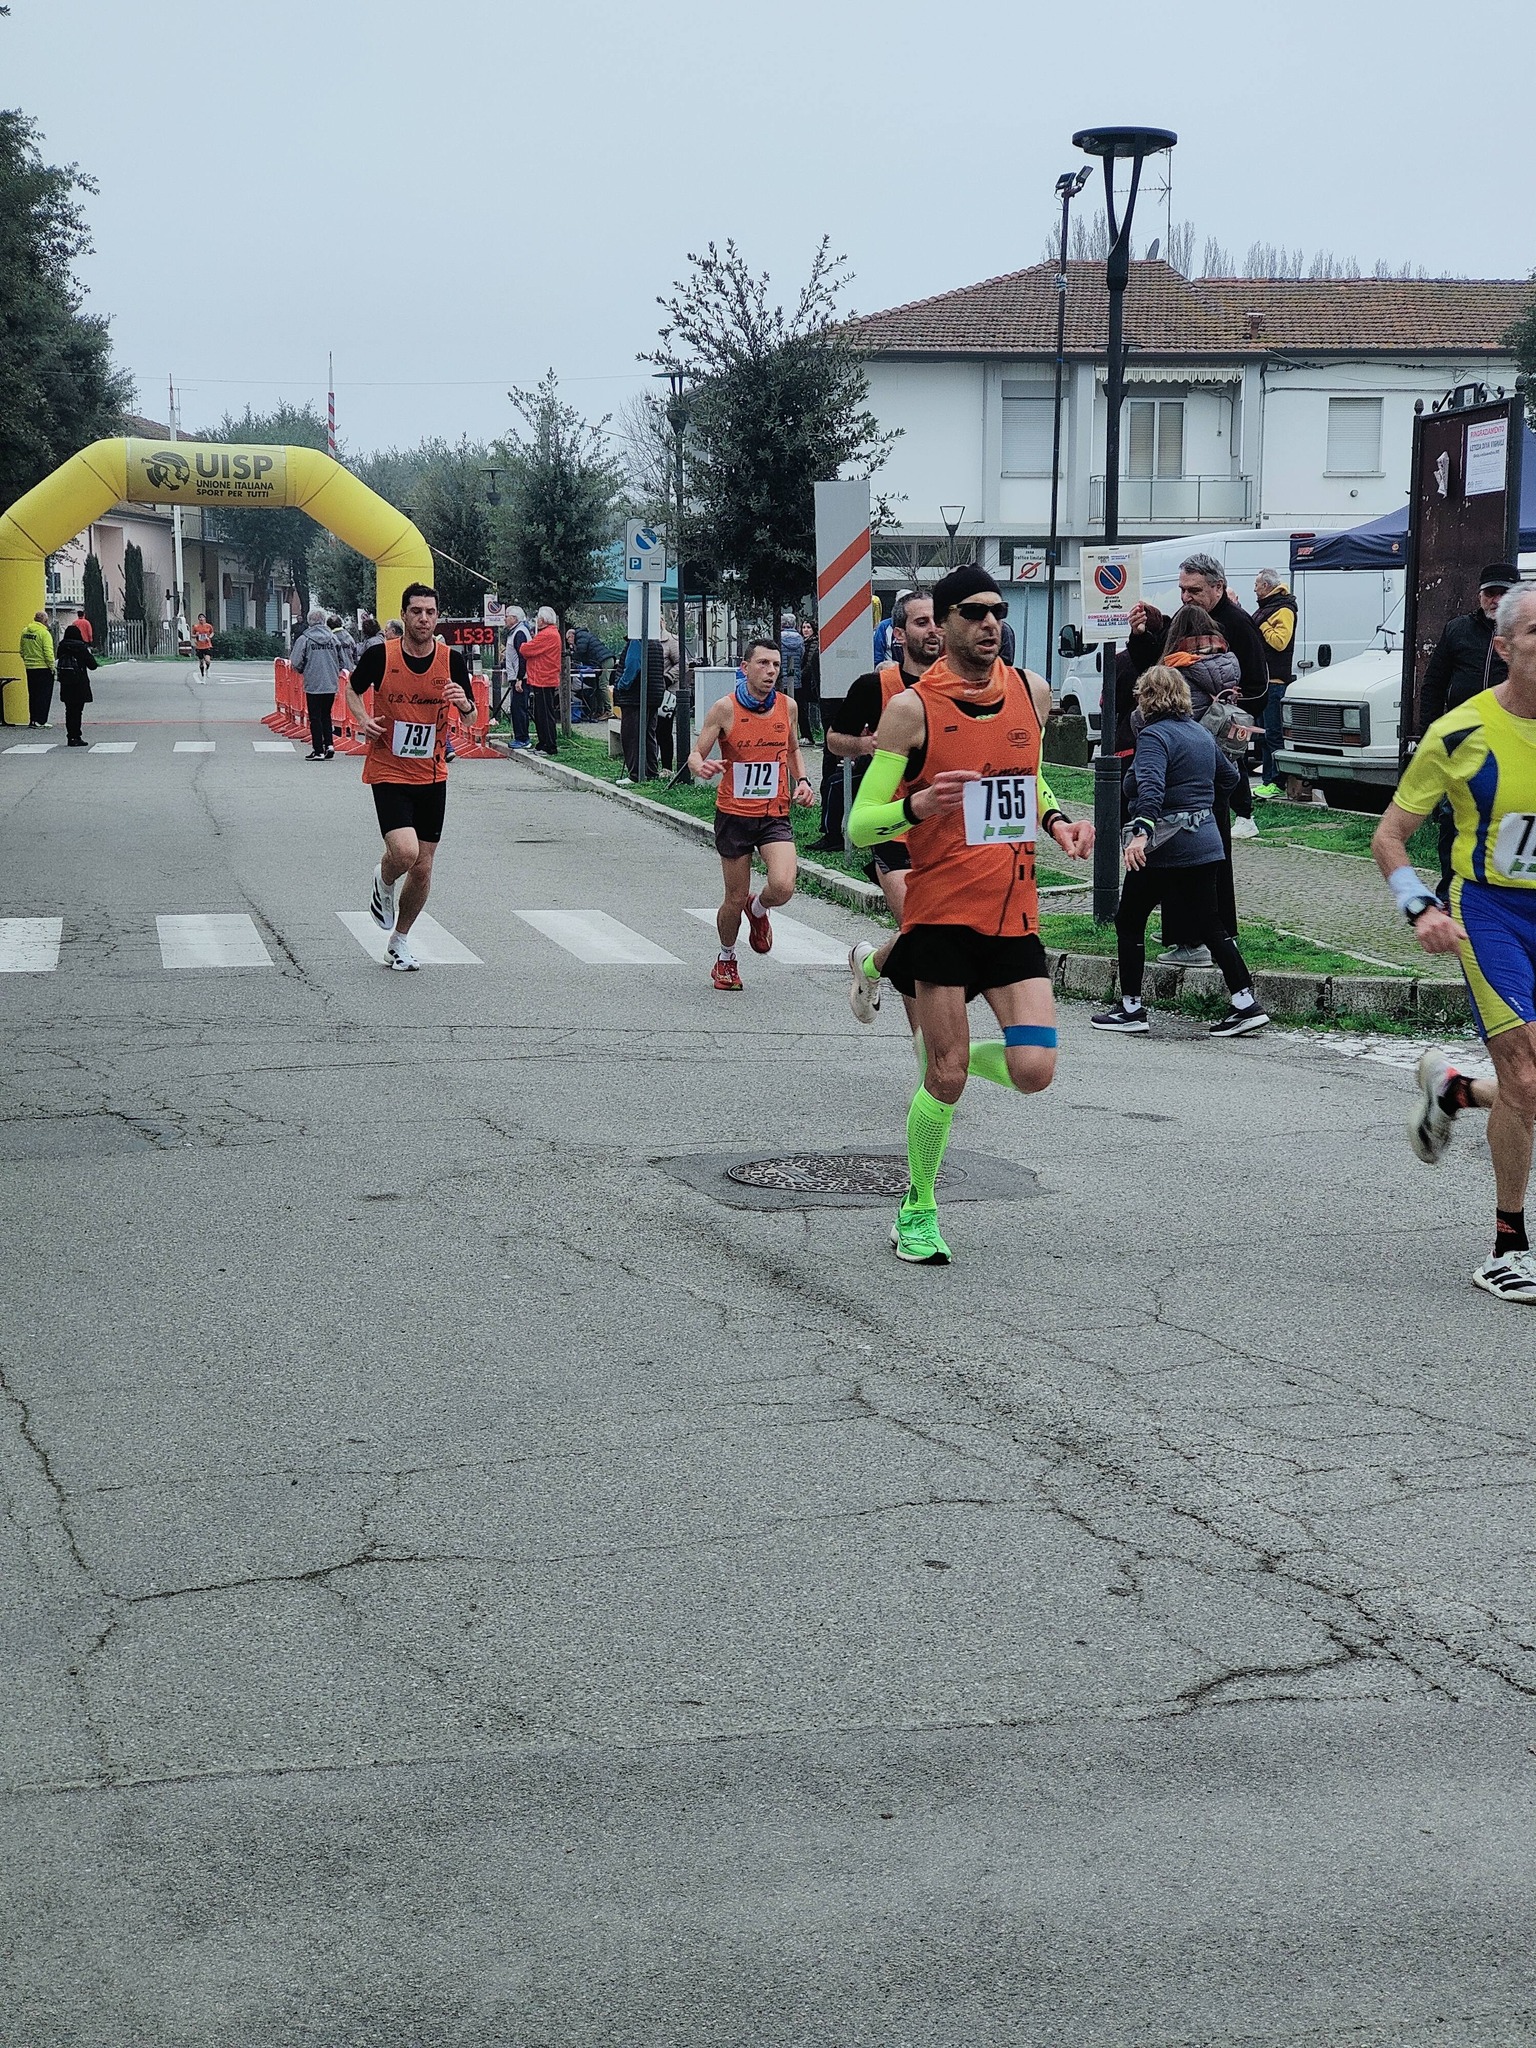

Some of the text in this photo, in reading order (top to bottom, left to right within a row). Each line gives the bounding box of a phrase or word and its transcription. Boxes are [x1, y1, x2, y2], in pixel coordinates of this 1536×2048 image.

[196, 453, 273, 479] UISP
[196, 480, 274, 490] UNIONE ITALIANA
[196, 489, 224, 497] SPORT
[404, 723, 432, 747] 737
[744, 763, 772, 786] 772
[981, 779, 1025, 820] 755
